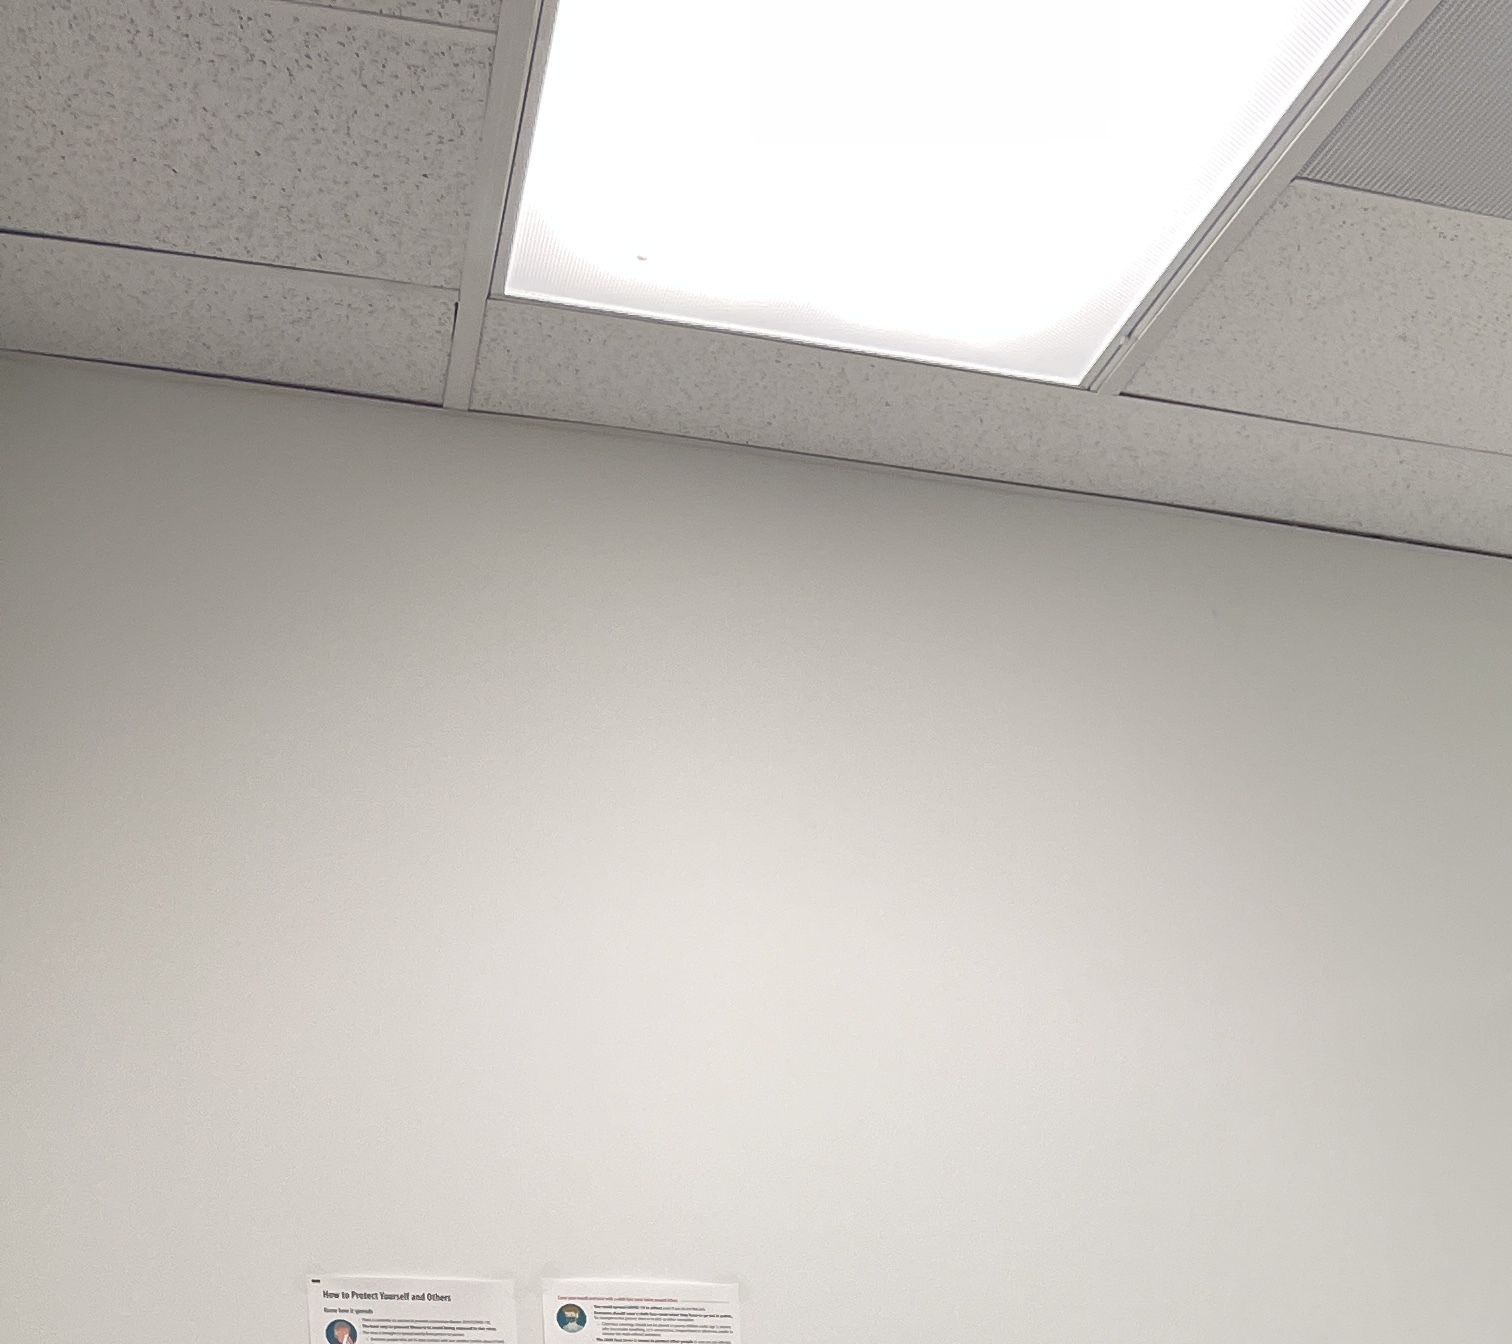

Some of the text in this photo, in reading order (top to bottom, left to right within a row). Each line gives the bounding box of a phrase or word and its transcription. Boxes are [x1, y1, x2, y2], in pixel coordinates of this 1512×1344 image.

[323, 1290, 451, 1302] How to Protect Yourself and Others
